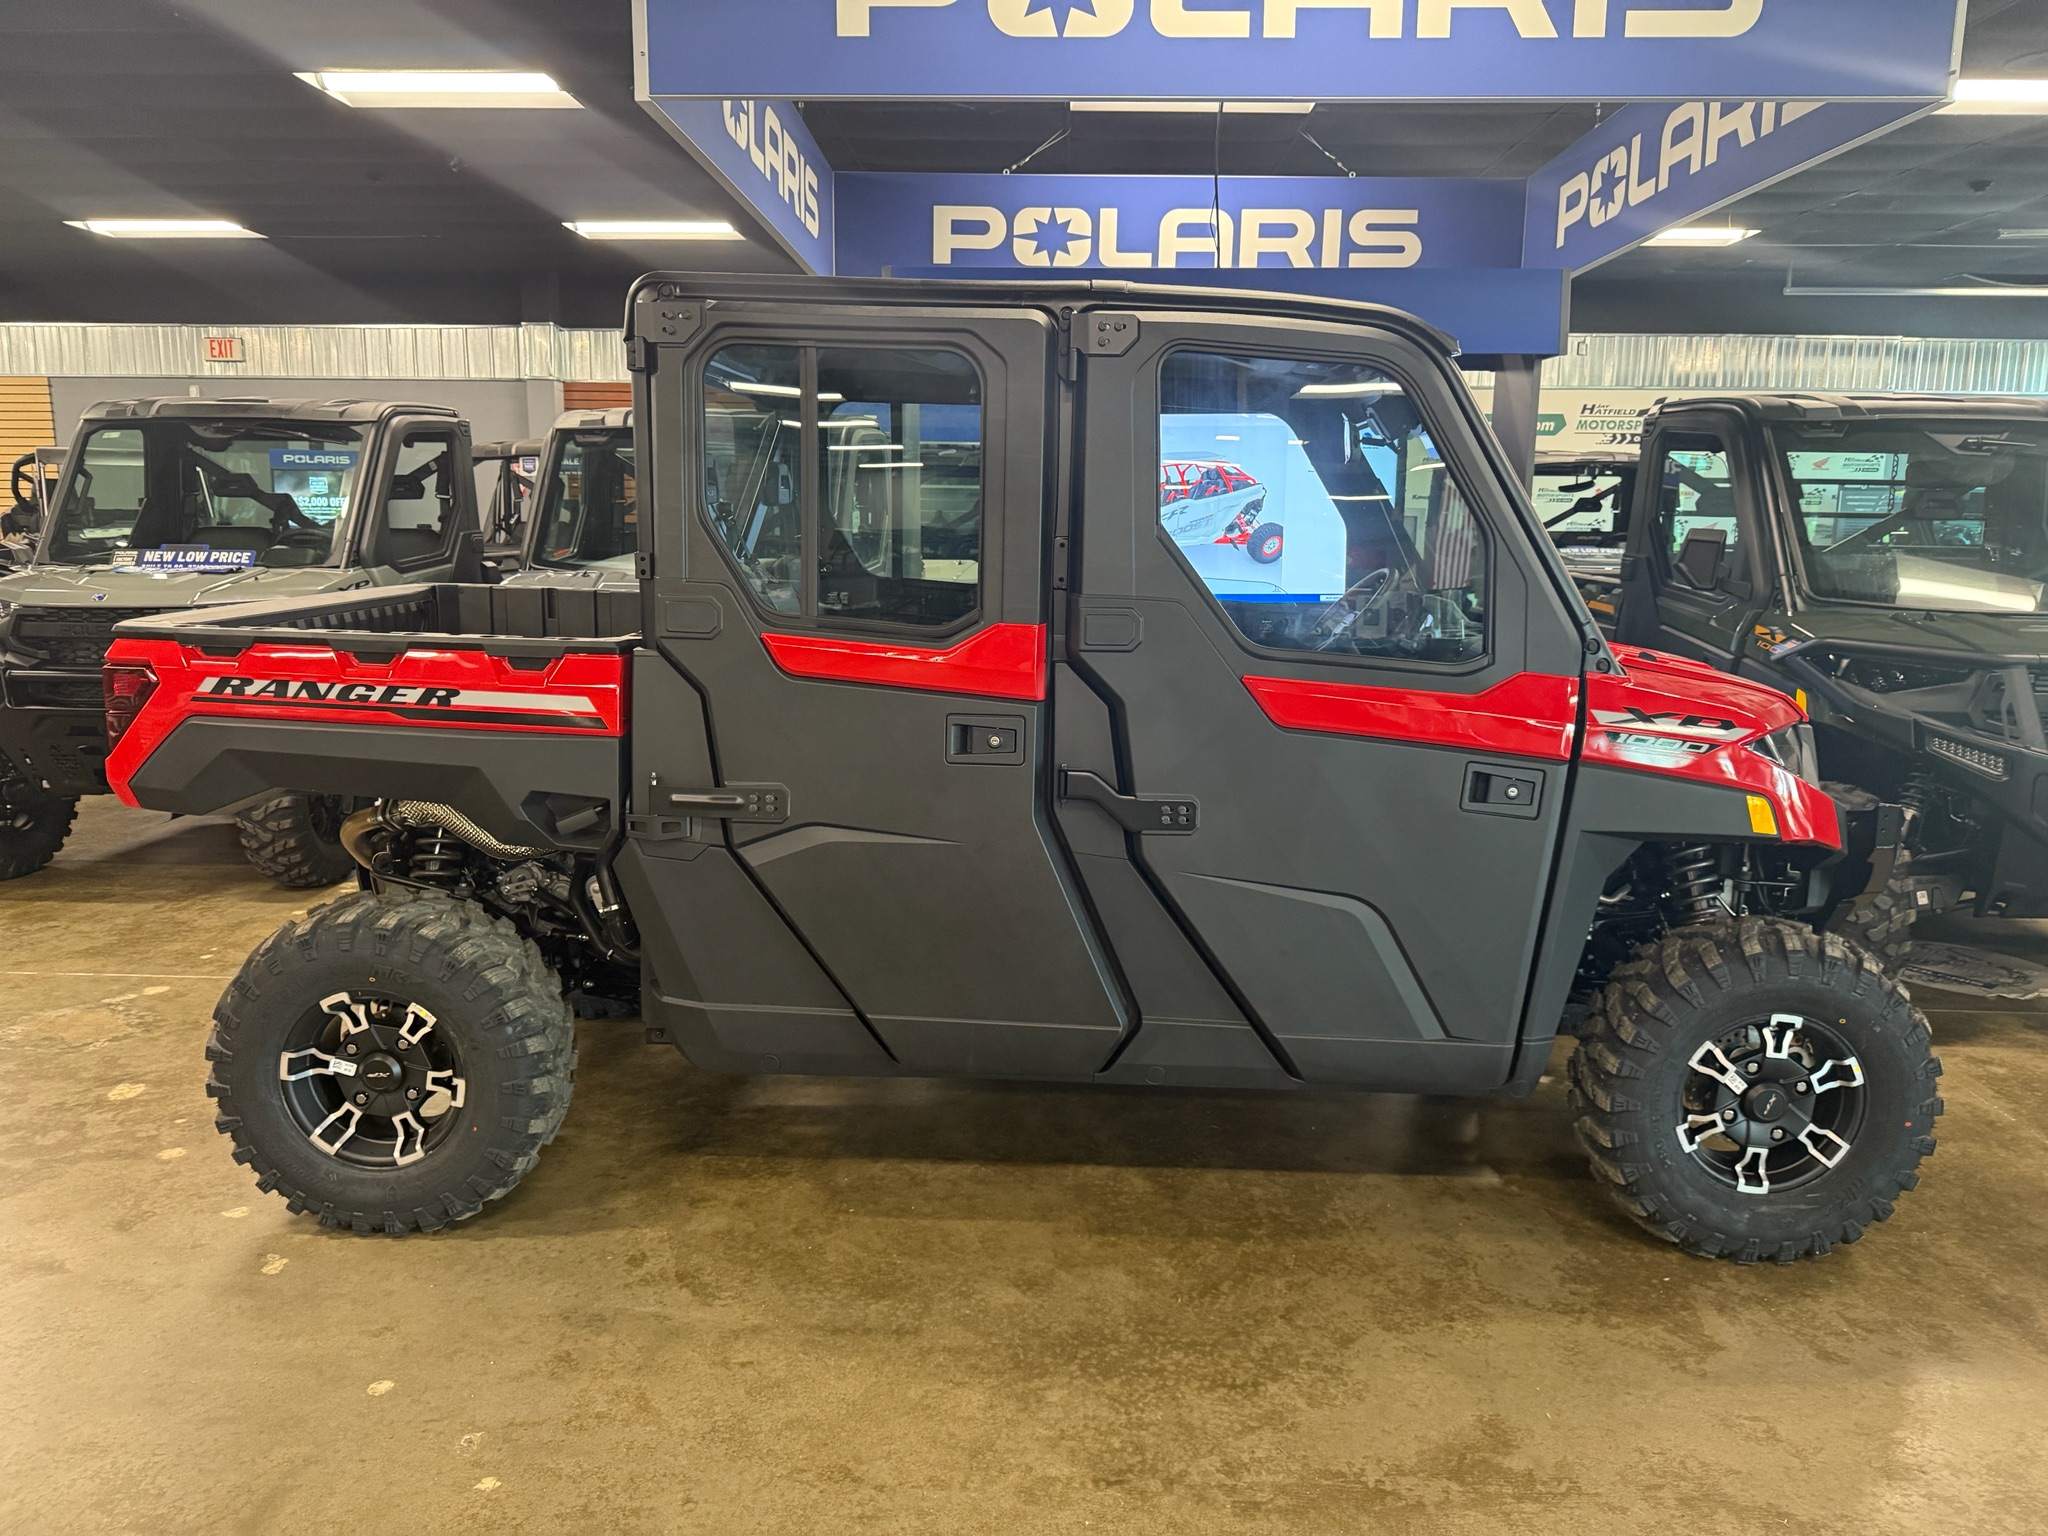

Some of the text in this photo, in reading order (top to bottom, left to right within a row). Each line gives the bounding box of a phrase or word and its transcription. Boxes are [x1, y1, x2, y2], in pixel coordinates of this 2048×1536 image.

[933, 205, 1422, 268] POLARIS
[209, 339, 233, 358] EXIT
[1580, 404, 1637, 415] HATFIELD
[1576, 420, 1642, 430] MOTORSP
[283, 455, 350, 464] POLARIS
[144, 551, 251, 563] NEW LOW PRICE
[208, 676, 460, 707] RANGER
[1606, 706, 1737, 730] XP
[1616, 733, 1710, 753] 1000
